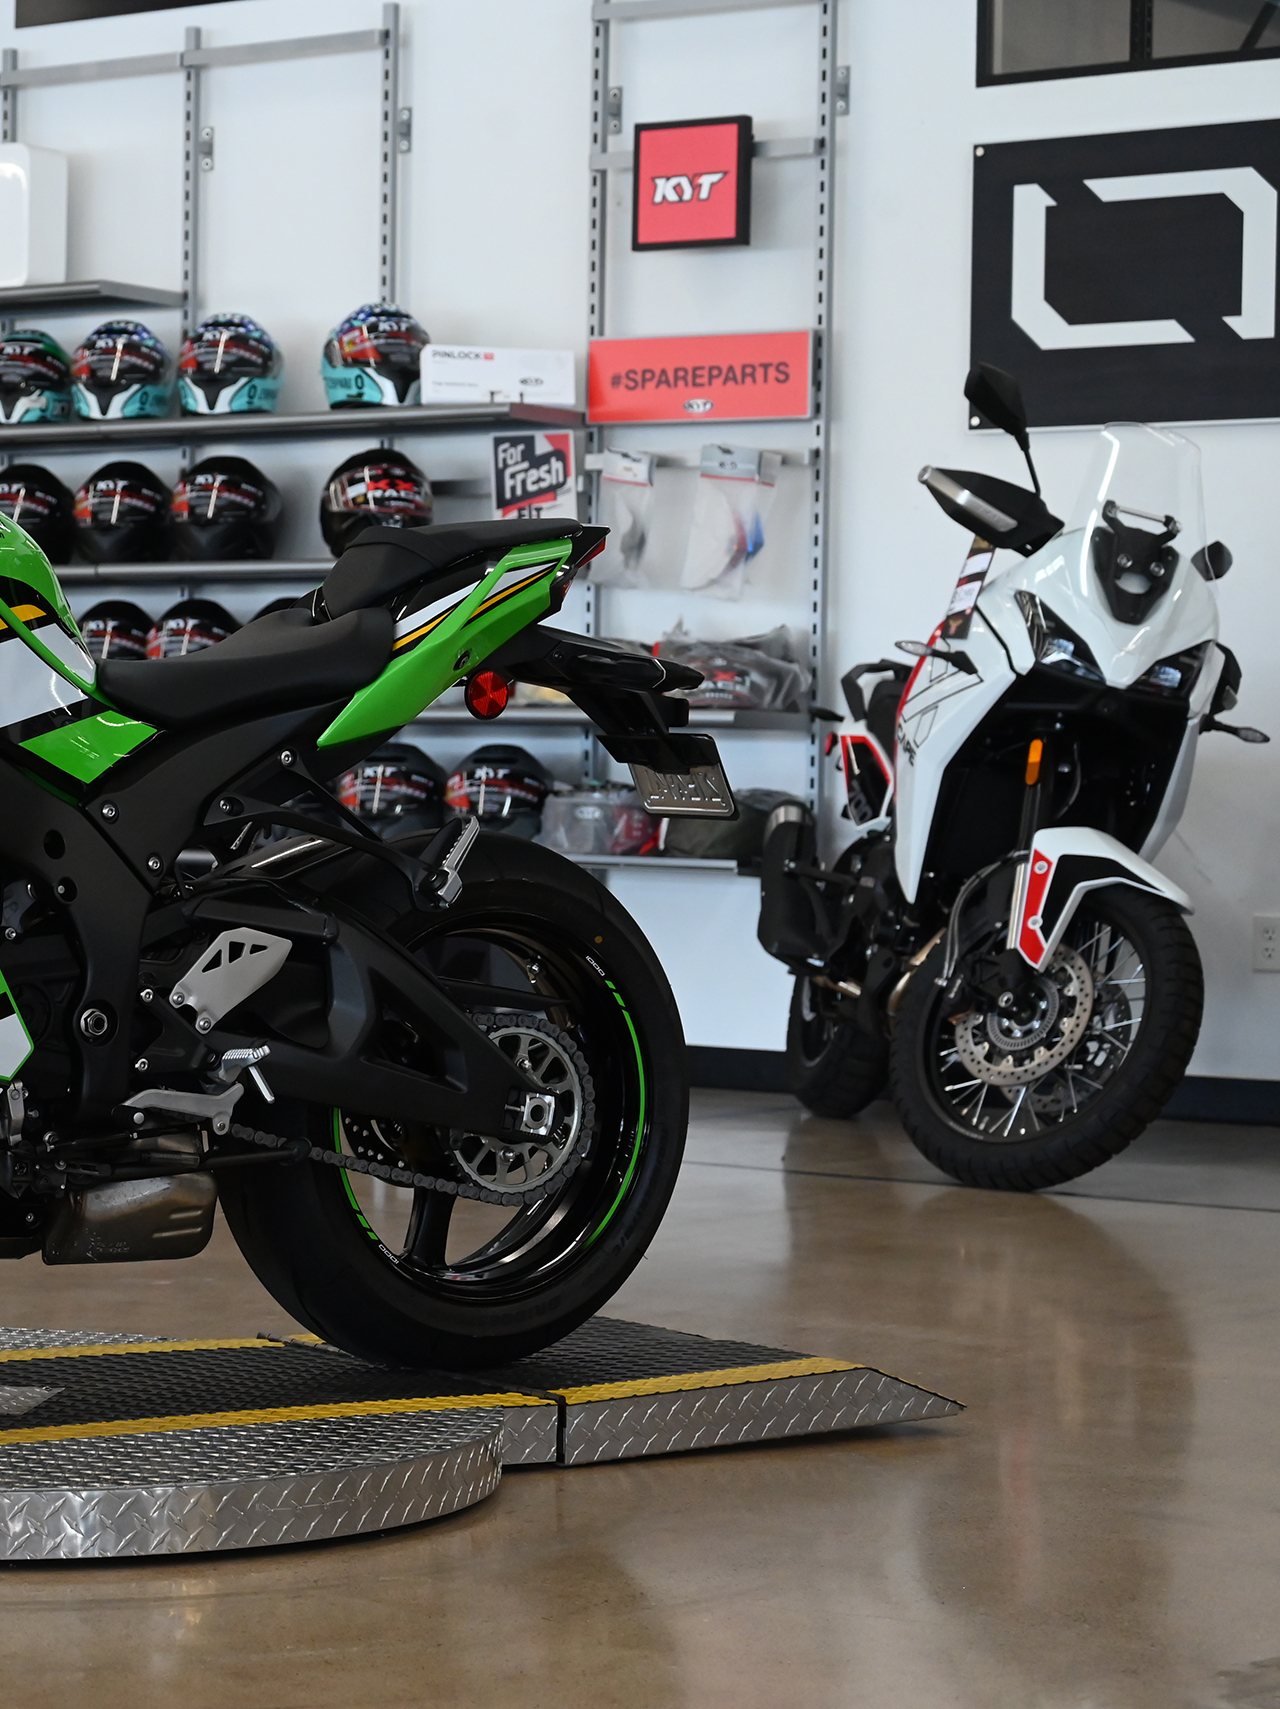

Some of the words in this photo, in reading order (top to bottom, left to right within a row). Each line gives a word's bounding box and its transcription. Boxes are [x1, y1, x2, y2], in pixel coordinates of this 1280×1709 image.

[652, 171, 729, 205] KYT
[610, 361, 790, 391] #SPAREPARTS
[497, 441, 525, 469] For
[504, 455, 565, 500] Fresh
[585, 955, 606, 977] 1000
